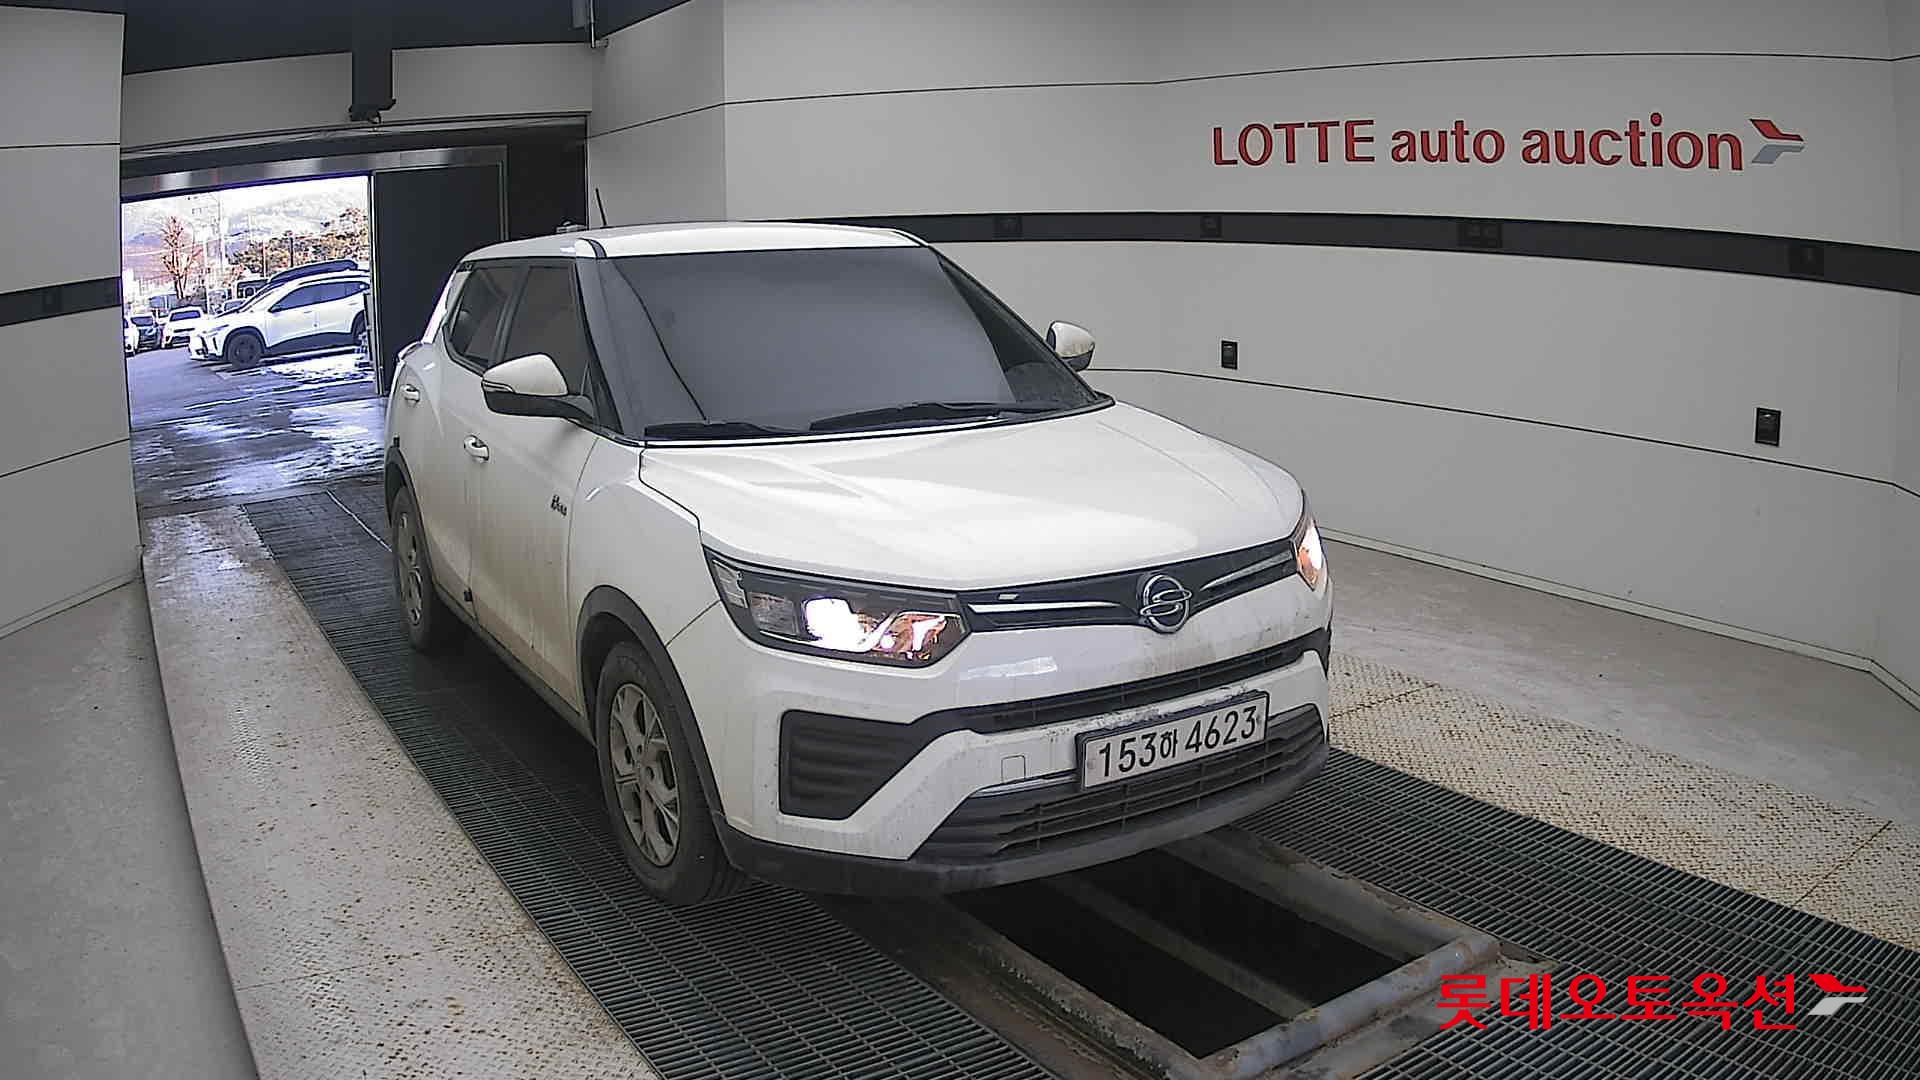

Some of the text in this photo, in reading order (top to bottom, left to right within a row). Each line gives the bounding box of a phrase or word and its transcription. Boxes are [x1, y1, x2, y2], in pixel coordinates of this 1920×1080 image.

[1213, 112, 1744, 171] LOTTE auto auction
[1098, 705, 1258, 777] 153하 4623
